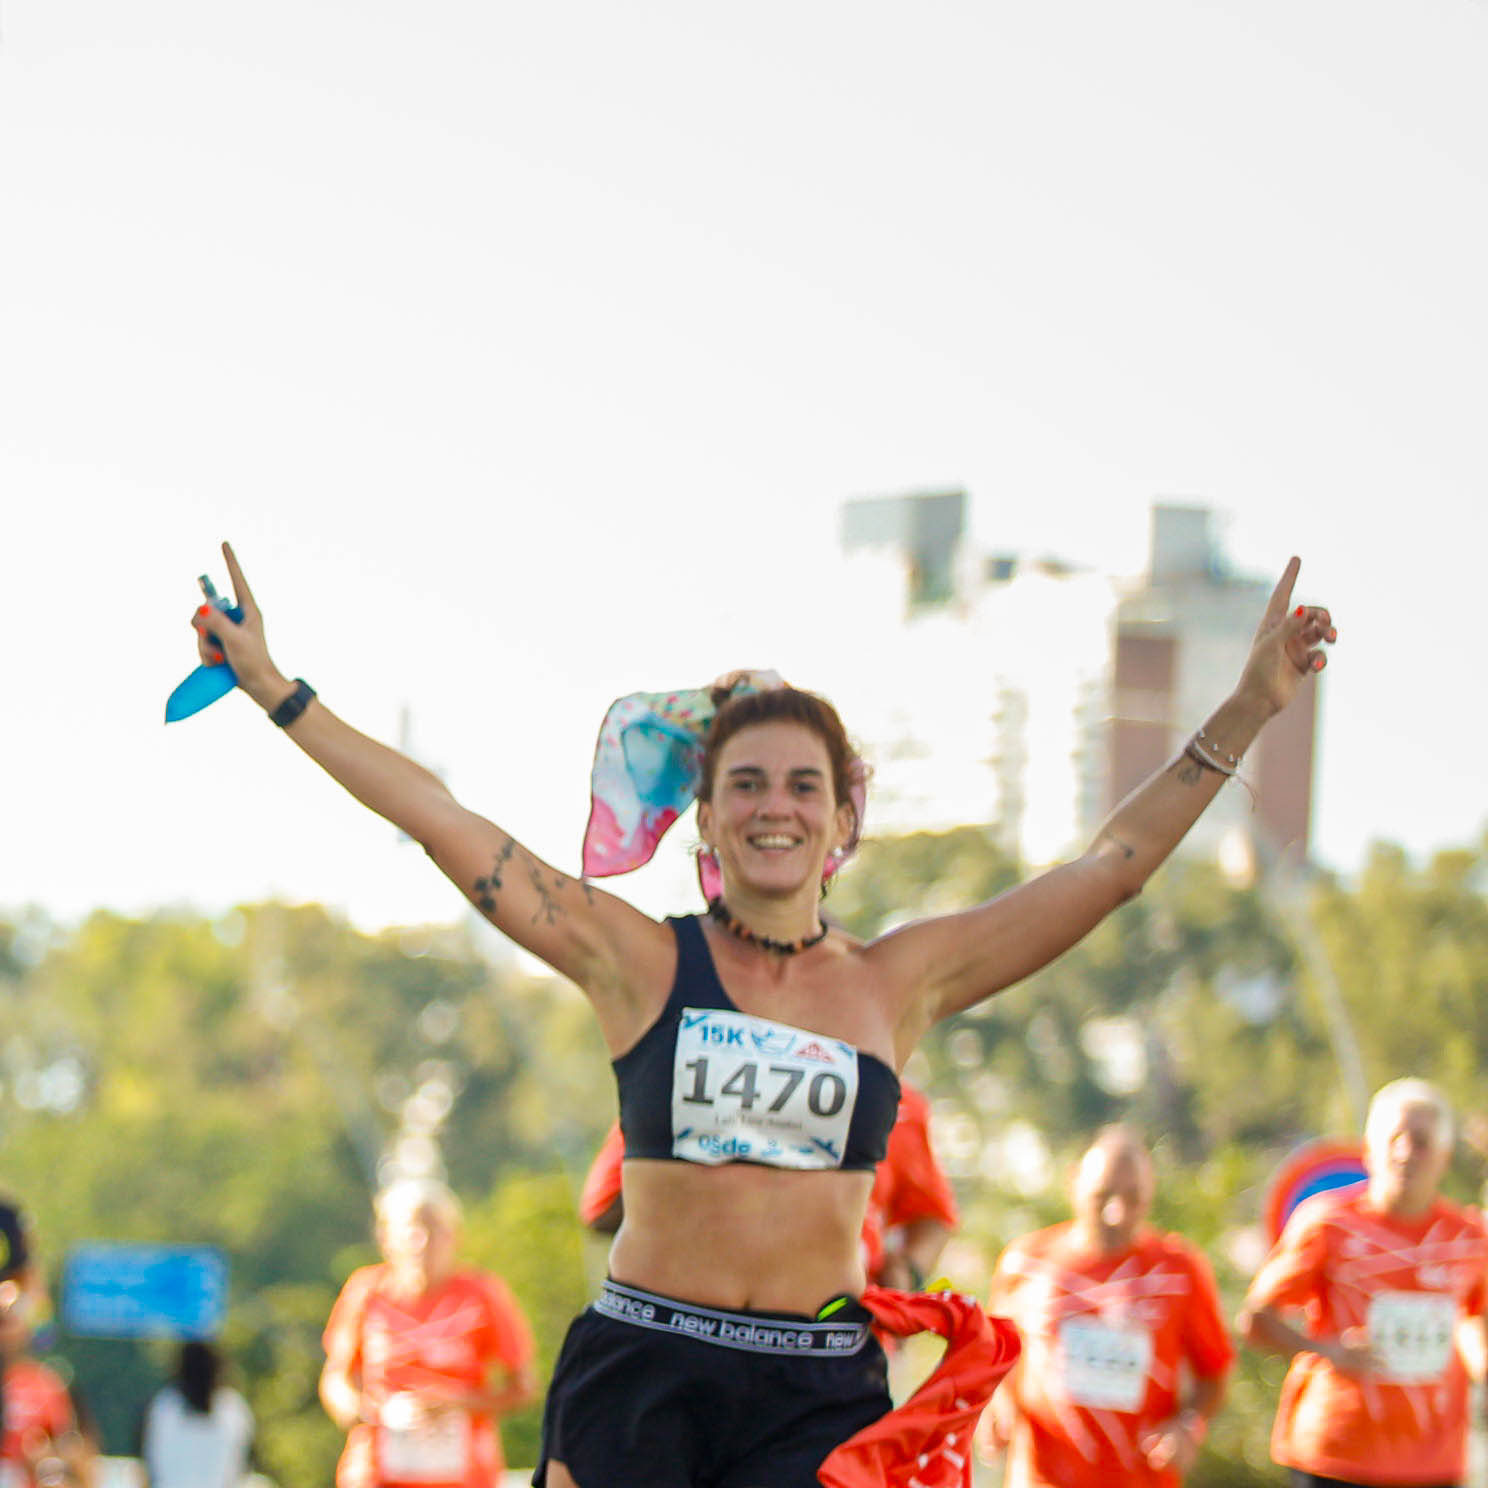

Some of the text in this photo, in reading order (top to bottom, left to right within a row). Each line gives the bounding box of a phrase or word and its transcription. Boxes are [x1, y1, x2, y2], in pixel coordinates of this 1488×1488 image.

[701, 1024, 744, 1046] 15K
[682, 1058, 847, 1117] 1470
[671, 1312, 716, 1337] new
[720, 1320, 813, 1350] balance
